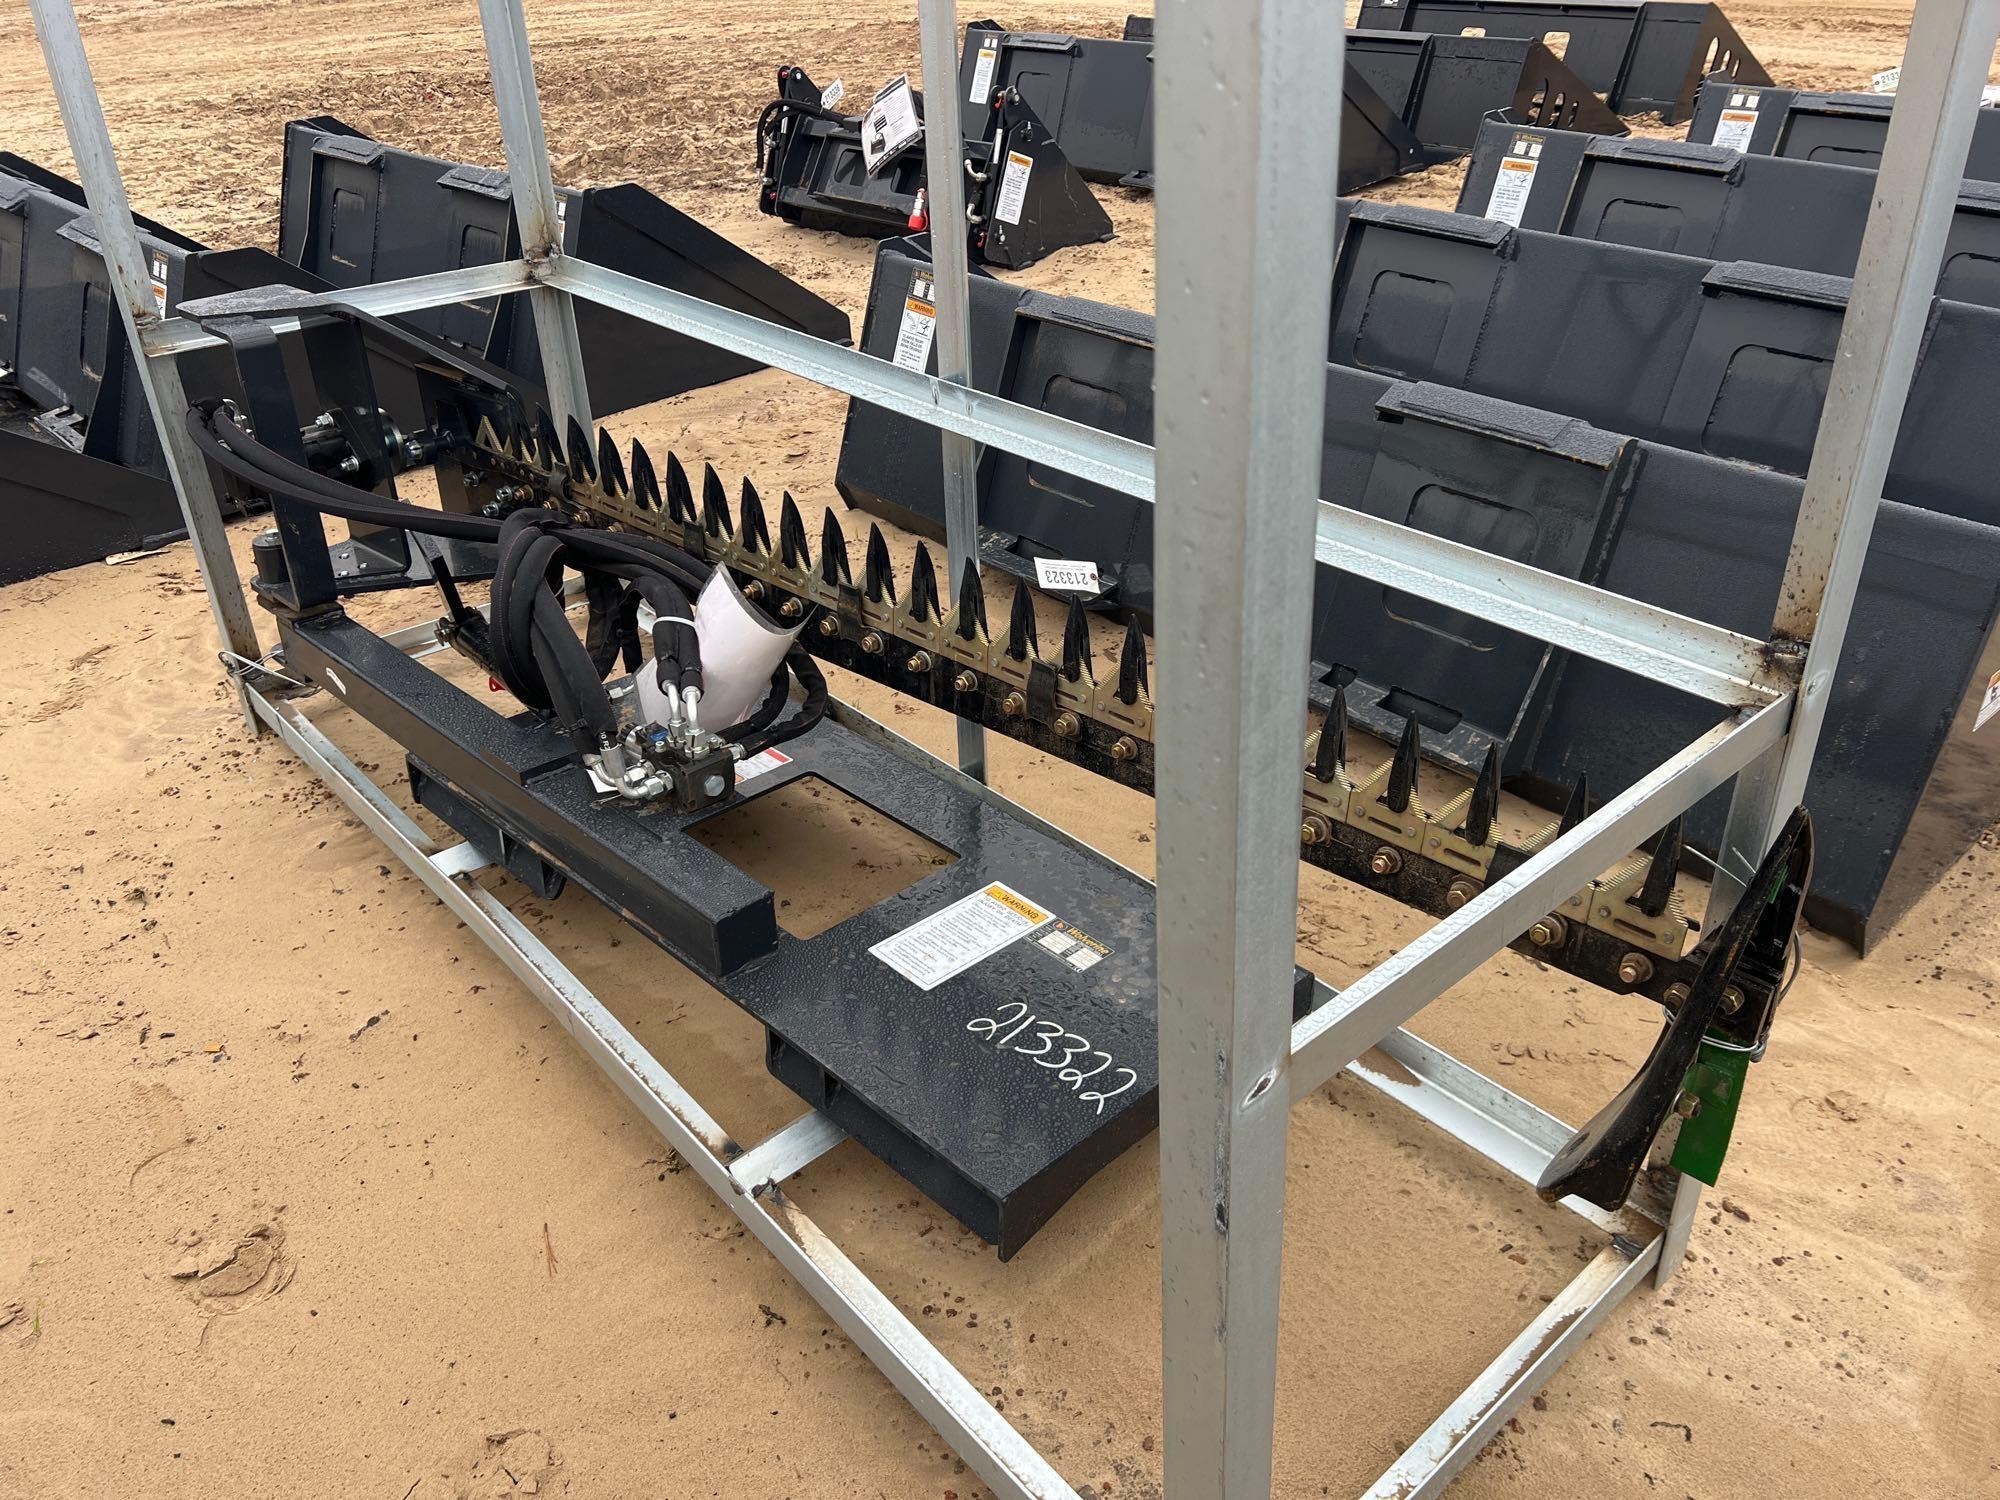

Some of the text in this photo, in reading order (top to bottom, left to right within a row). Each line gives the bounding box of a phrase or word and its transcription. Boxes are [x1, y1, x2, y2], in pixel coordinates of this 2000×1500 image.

[1881, 71, 1899, 84] 2133
[914, 303, 934, 315] WARNING
[1045, 570, 1089, 586] 213323
[1001, 894, 1039, 919] WARNING
[1067, 926, 1110, 955] Wolverine
[966, 1002, 1138, 1115] 213322
